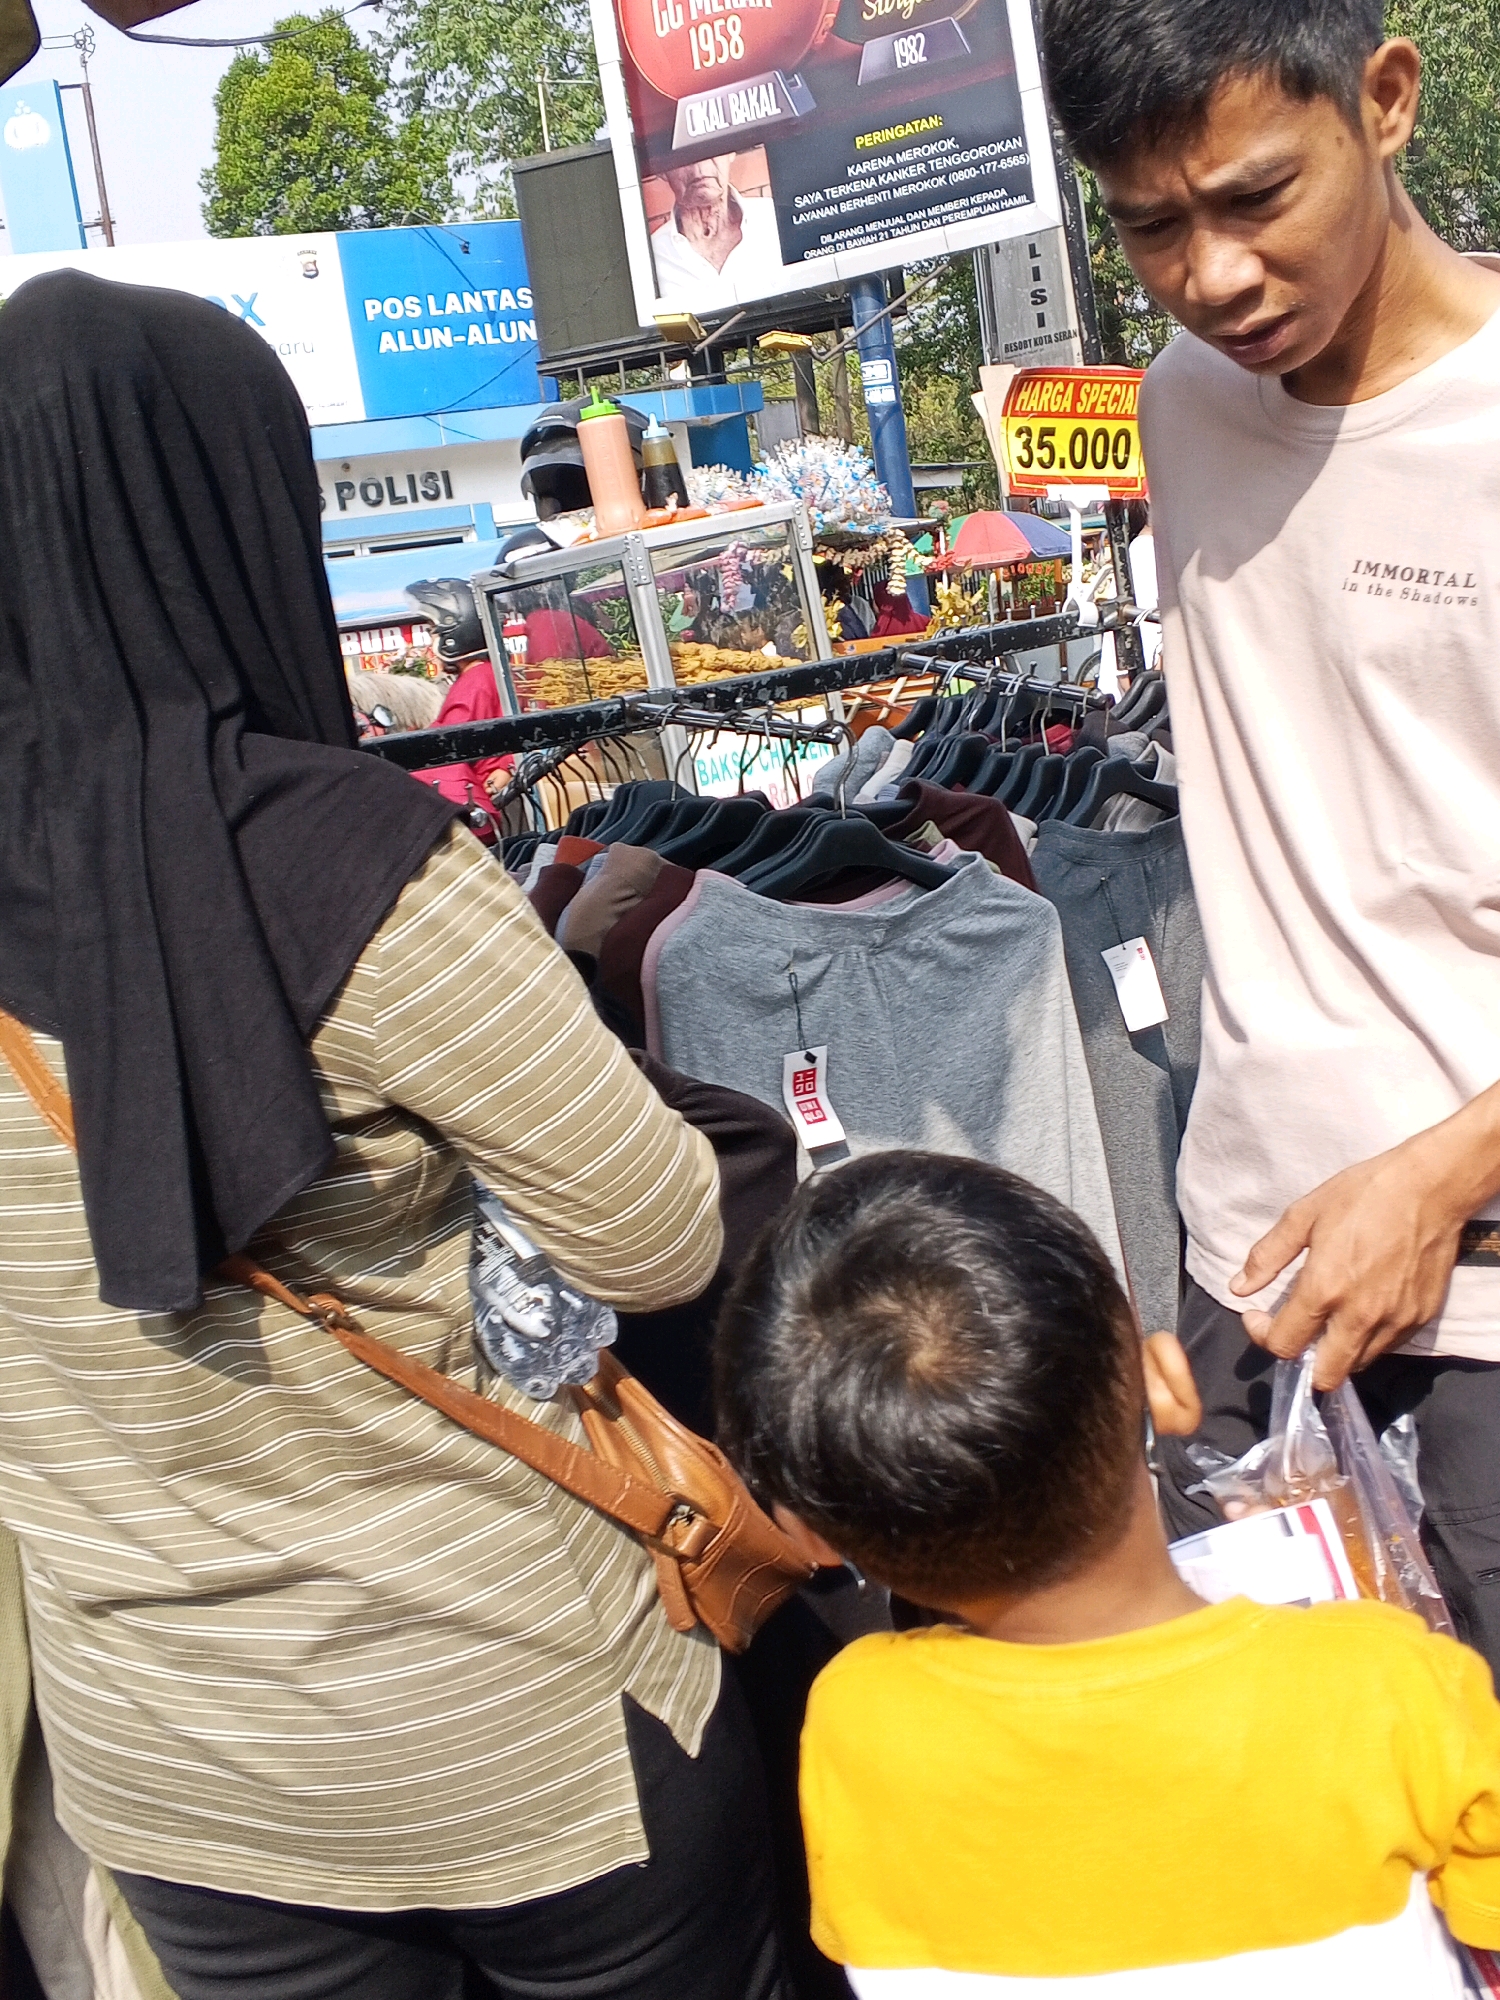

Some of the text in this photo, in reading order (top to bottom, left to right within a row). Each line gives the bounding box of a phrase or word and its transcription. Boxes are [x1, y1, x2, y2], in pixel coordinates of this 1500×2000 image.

[688, 14, 746, 71] 1958
[893, 33, 928, 69] 1982
[728, 83, 782, 126] BAKAL
[855, 114, 944, 150] PERINGATAN:
[794, 135, 1023, 208] SAYA TERKENA KANKER TENGGOROKAN
[847, 137, 960, 177] KARENA MEROKOK,
[792, 152, 1030, 225] LAYANAN BERHENTI MEROKOK (0800-177-6565)
[803, 194, 1031, 260] ORANG DI BAWAH 21 TAHUN DAN PEREMPUAN HAMIL
[820, 188, 1009, 245] DILARANG MENJUAL DAN MEMBERI KEPADA
[363, 287, 534, 322] POS LANTAS
[378, 319, 538, 354] ALUN-ALUN
[1033, 333, 1053, 347] KOTA
[1053, 328, 1079, 343] SERAN
[1014, 380, 1075, 413] HARGA
[1014, 425, 1132, 470] 35.000
[334, 470, 454, 511] POLISI
[1341, 577, 1479, 607] in the Shadows
[1351, 559, 1478, 589] IMMORTAL
[696, 748, 755, 787] BAKSO
